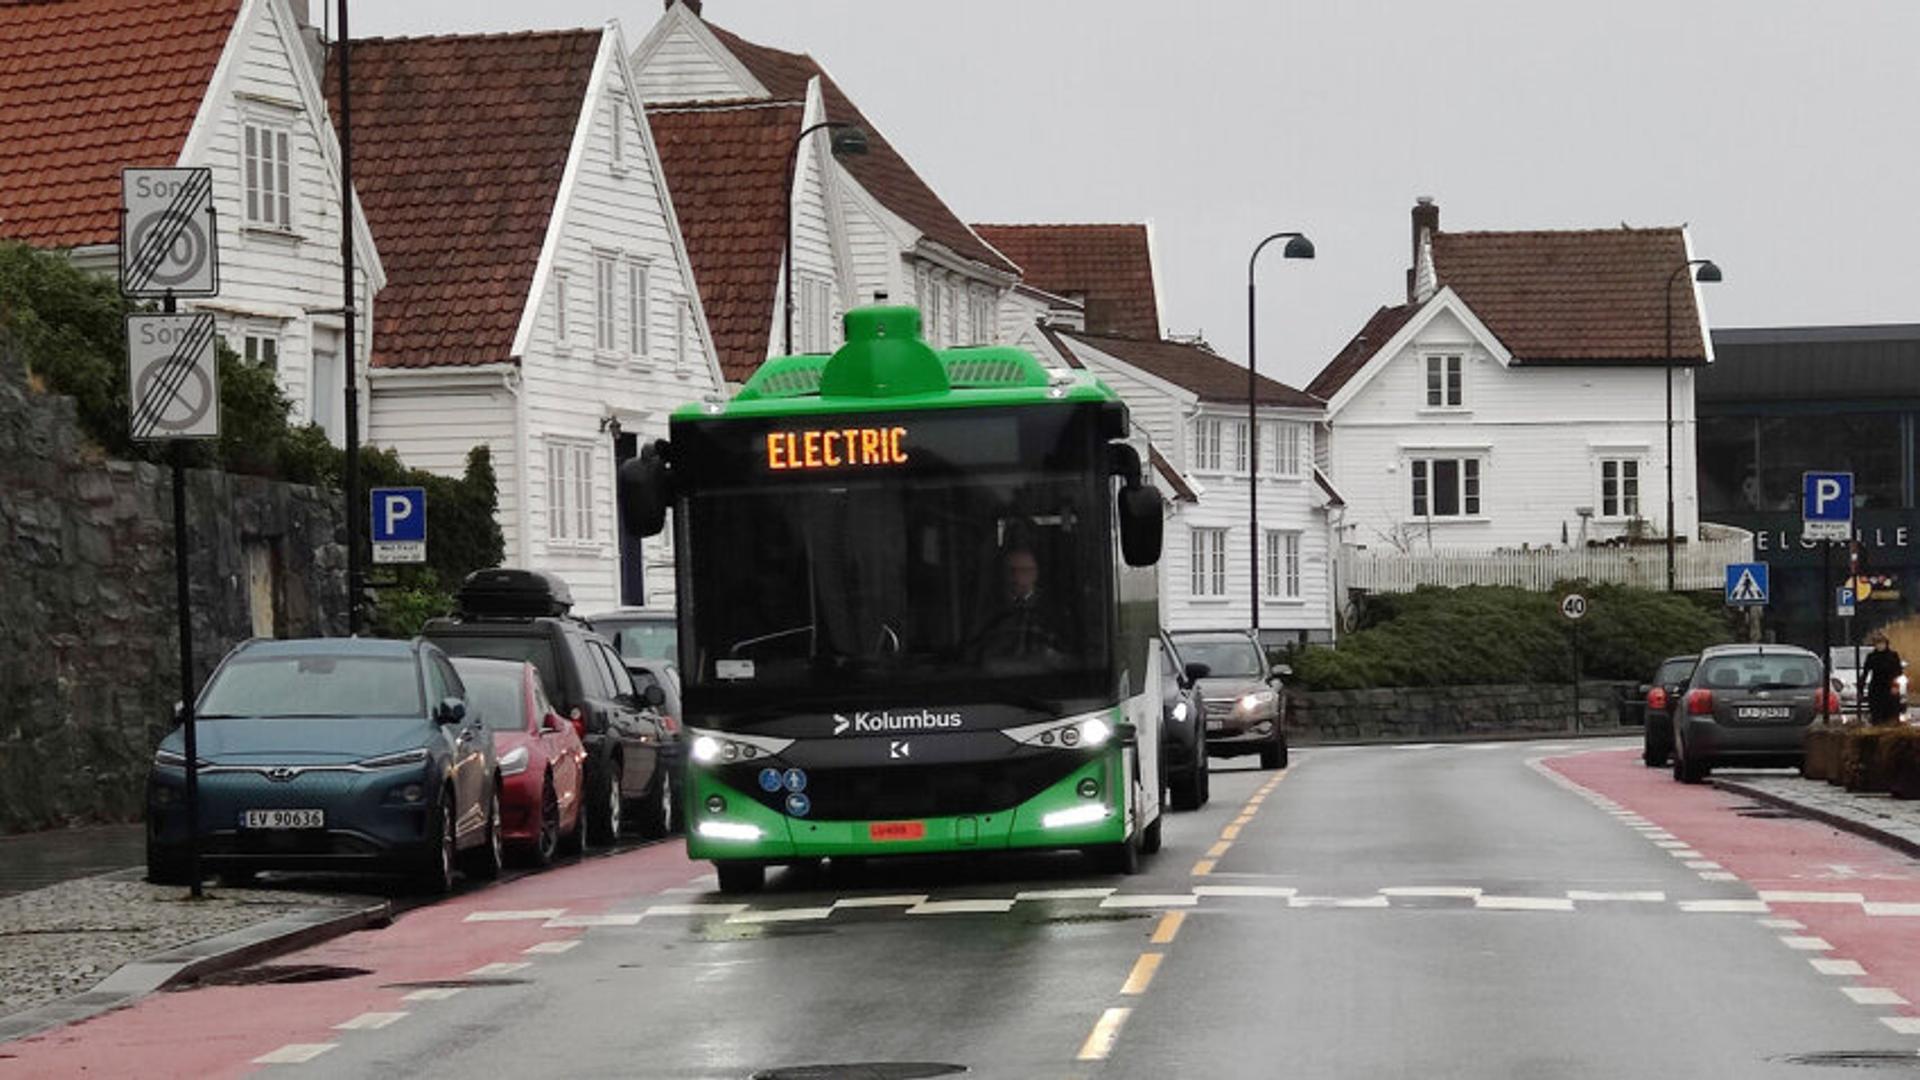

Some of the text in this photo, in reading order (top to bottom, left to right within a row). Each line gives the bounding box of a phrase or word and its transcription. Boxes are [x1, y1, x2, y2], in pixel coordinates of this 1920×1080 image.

[767, 427, 908, 469] ELECTRIC
[1816, 479, 1841, 514] P
[385, 495, 411, 535] P
[1565, 599, 1584, 613] 40
[1843, 590, 1853, 604] P
[855, 709, 962, 731] Kolumbus
[249, 811, 321, 826] EV 90636
